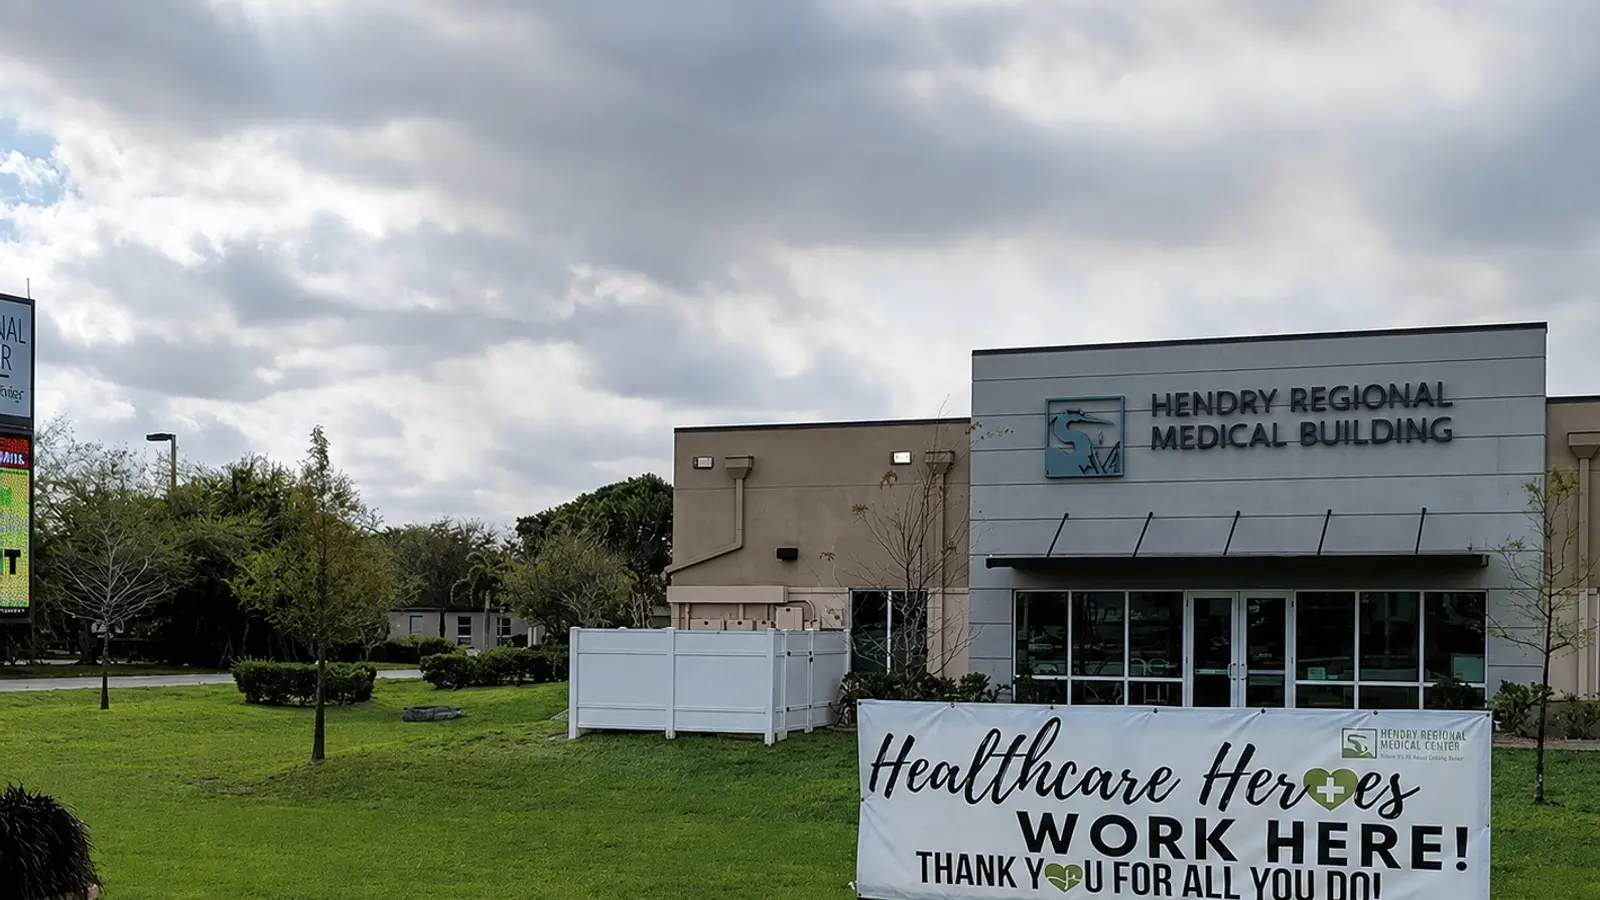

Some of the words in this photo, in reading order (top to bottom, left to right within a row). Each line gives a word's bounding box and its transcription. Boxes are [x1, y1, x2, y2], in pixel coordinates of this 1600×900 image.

[1151, 388, 1278, 418] HENDRY
[1290, 381, 1453, 412] REGIONAL
[1150, 421, 1288, 451] MEDICAL
[1300, 416, 1453, 446] BUILDING
[1381, 729, 1418, 740] HENDRY
[1421, 730, 1467, 741] REGIONAL
[1381, 740, 1421, 750] MEDICAL
[1425, 741, 1460, 751] CENTER
[868, 716, 1181, 805] Healthcare
[1199, 741, 1420, 819] Heres
[1016, 811, 1238, 863] WORK
[1267, 820, 1469, 872] HERE!
[916, 851, 1016, 888] THANK
[1025, 857, 1101, 894] YU
[1114, 861, 1172, 896] FOR
[1182, 865, 1240, 899] ALL
[1250, 867, 1314, 900] YOU
[1327, 871, 1381, 900] DO!
